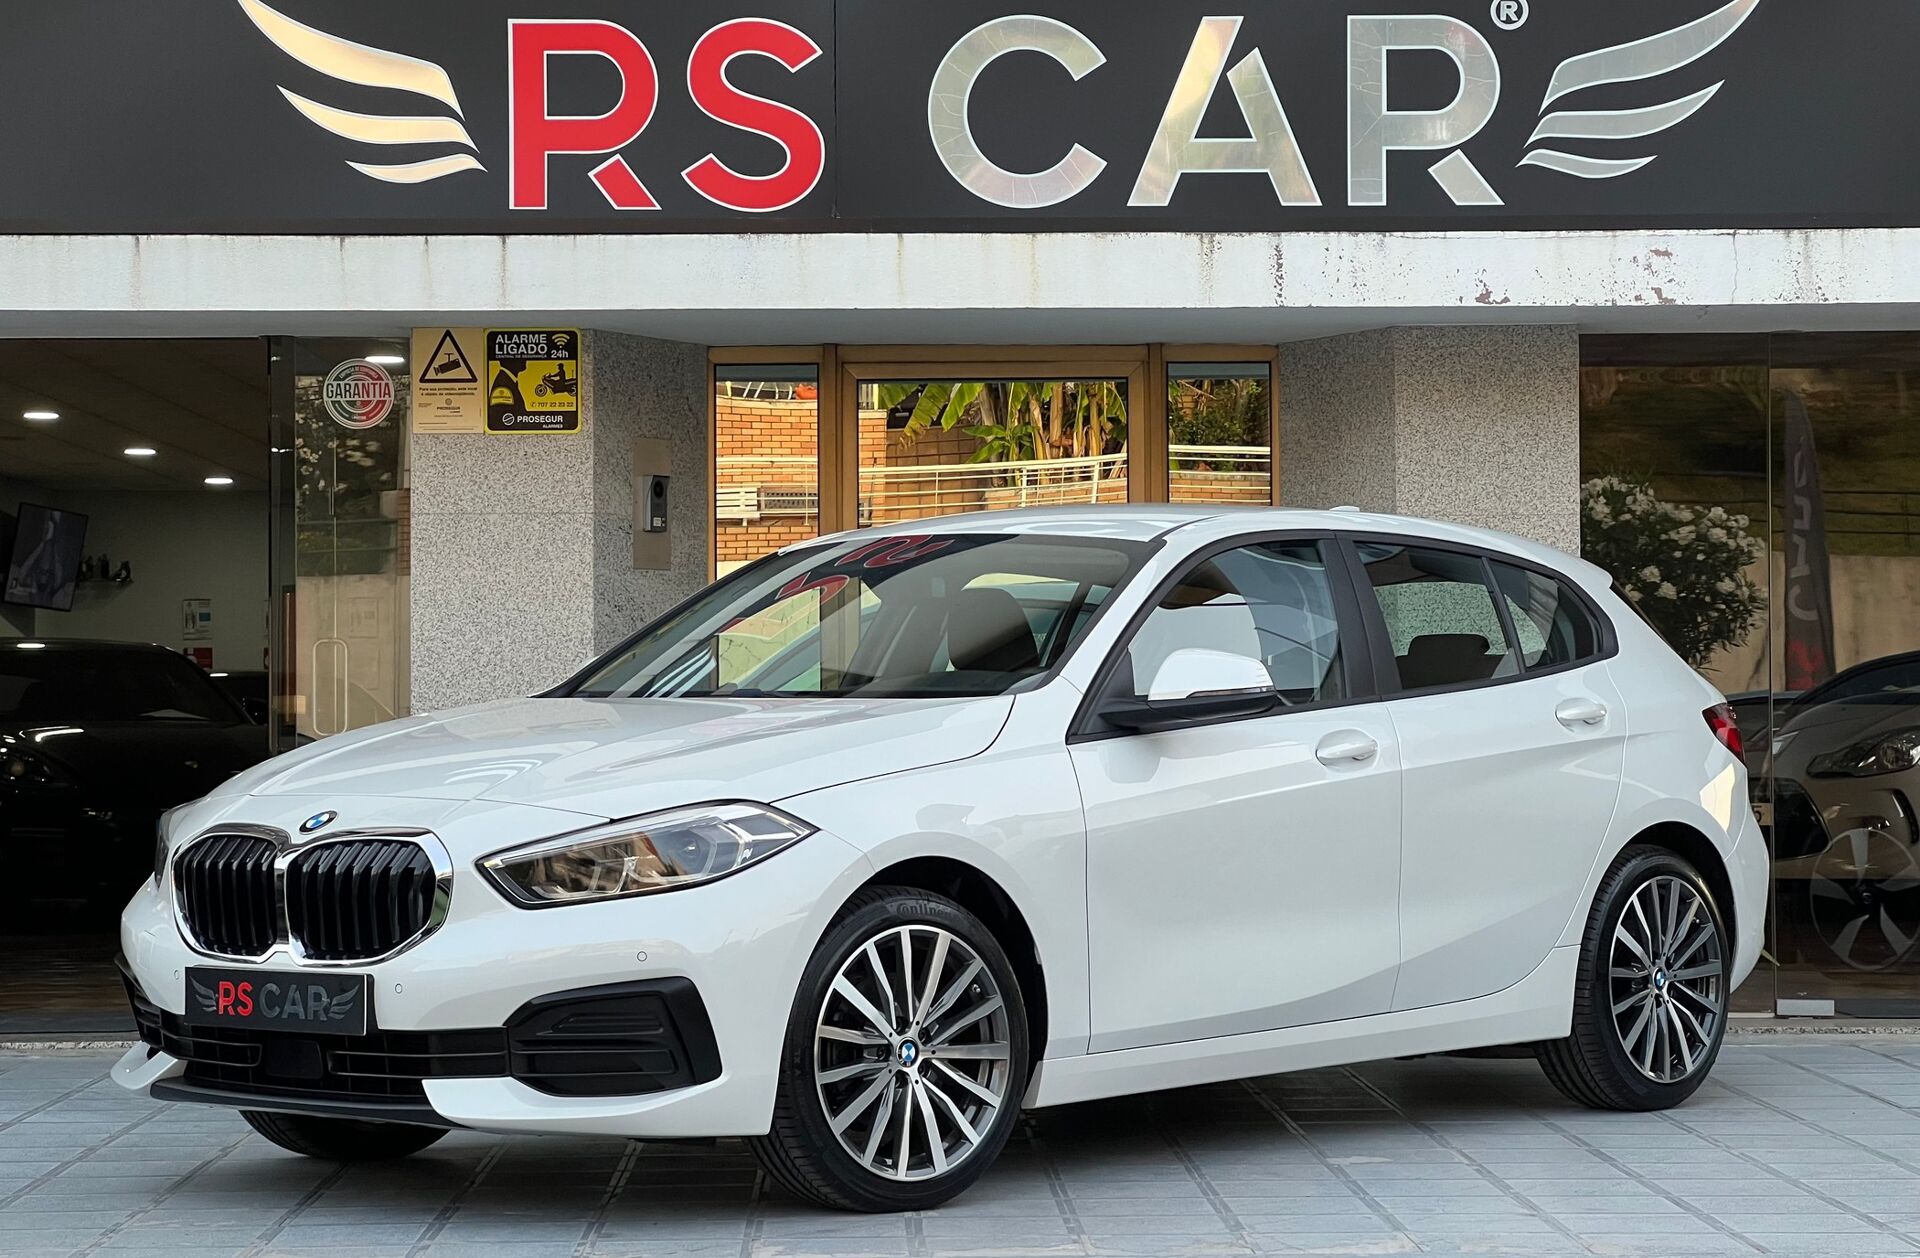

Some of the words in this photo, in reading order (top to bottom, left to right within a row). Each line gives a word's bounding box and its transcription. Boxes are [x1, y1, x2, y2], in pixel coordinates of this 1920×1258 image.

[508, 17, 826, 212] RS
[927, 14, 1505, 209] CAR
[495, 334, 548, 344] ALARME
[495, 344, 548, 355] LIGADO
[550, 349, 569, 359] 24h
[326, 382, 392, 399] GARANTIA
[516, 415, 563, 423] PROSEGUR
[218, 980, 254, 1016] RS
[259, 982, 328, 1021] CAR
